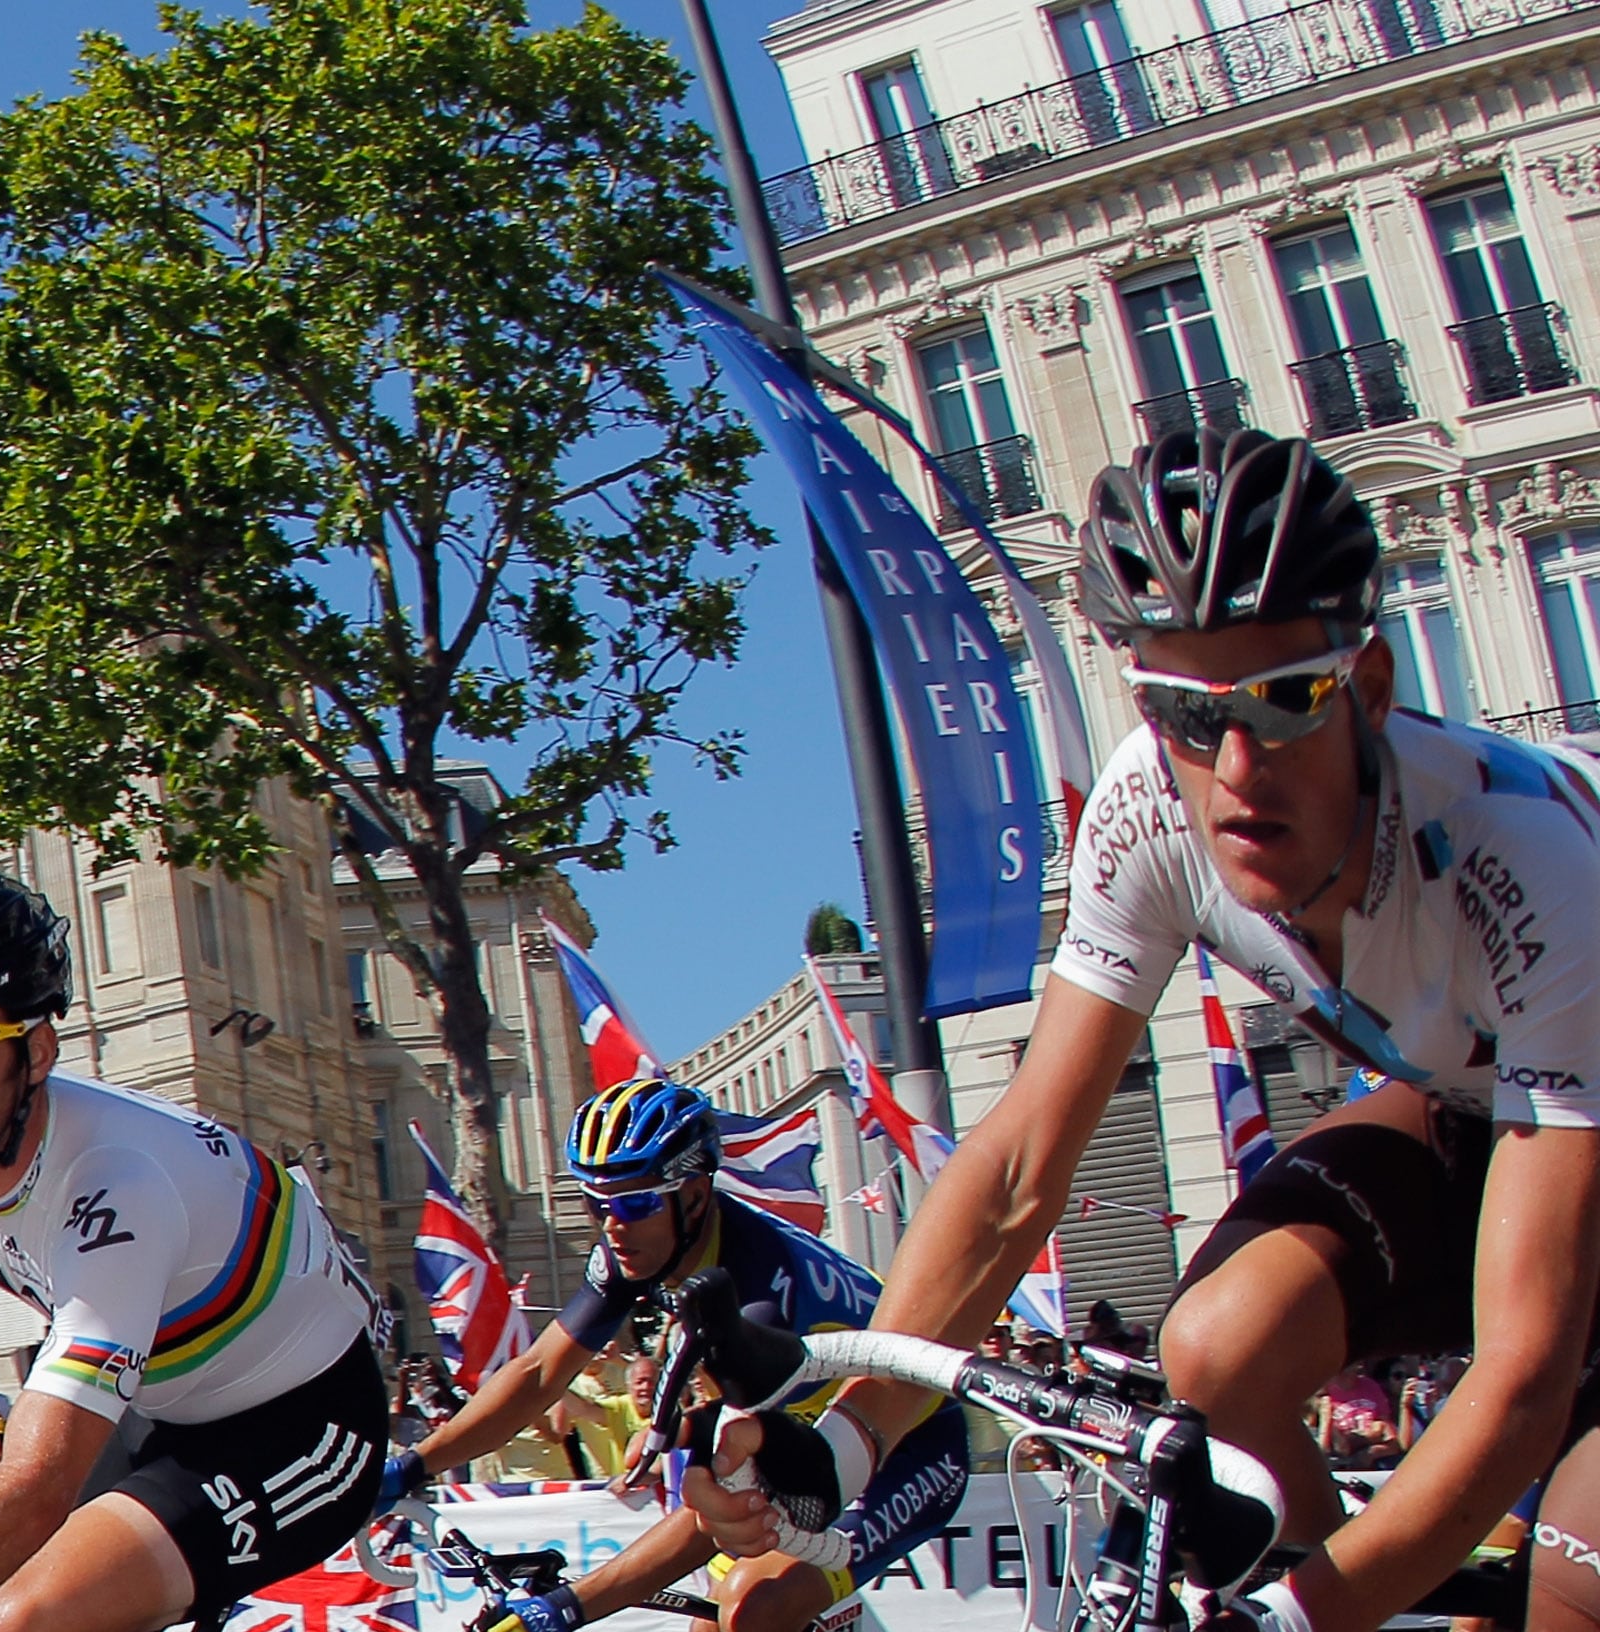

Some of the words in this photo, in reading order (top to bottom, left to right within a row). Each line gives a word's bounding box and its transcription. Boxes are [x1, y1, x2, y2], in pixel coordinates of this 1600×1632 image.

[761, 380, 961, 736] MAIRIE
[913, 550, 1028, 883] PARIS
[201, 1474, 260, 1565] sky
[849, 1452, 962, 1564] SAXOBANK
[1140, 1494, 1169, 1620] SRAM
